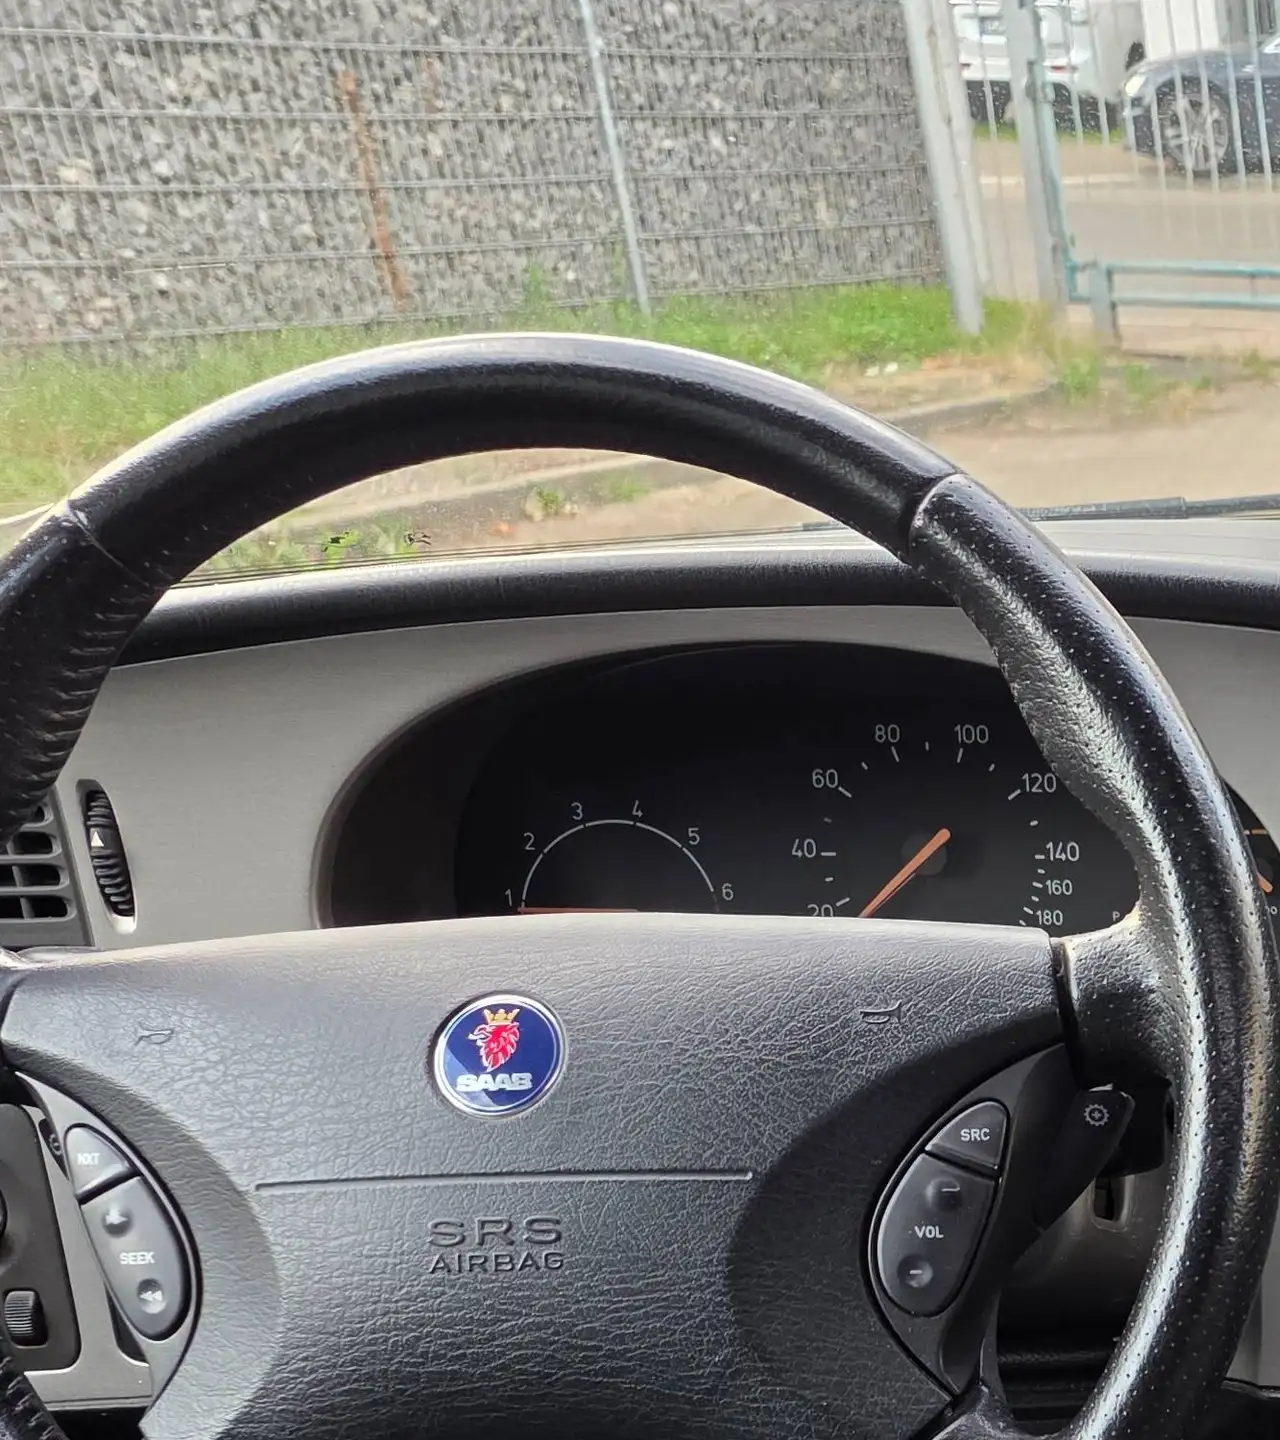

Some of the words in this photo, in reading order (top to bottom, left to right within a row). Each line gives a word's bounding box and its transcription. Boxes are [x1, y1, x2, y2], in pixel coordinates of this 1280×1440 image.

[875, 724, 900, 743] 80
[954, 725, 989, 744] 100
[812, 769, 838, 788] 60
[1021, 773, 1057, 793] 120
[571, 802, 583, 820] 3
[632, 800, 643, 818] 4
[523, 832, 535, 850] 2
[688, 828, 700, 845] 5
[791, 838, 817, 858] 40
[1045, 842, 1080, 862] 140
[721, 883, 734, 900] 6
[1045, 879, 1073, 896] 160
[505, 889, 513, 906] 1
[1036, 909, 1064, 926] 180
[456, 1072, 533, 1091] SAAB
[960, 1127, 991, 1142] SRC
[77, 1152, 100, 1165] NXT
[427, 1215, 563, 1247] SRS
[915, 1226, 944, 1239] VOL
[120, 1251, 156, 1265] SEEK
[428, 1251, 565, 1275] AIRBAG
